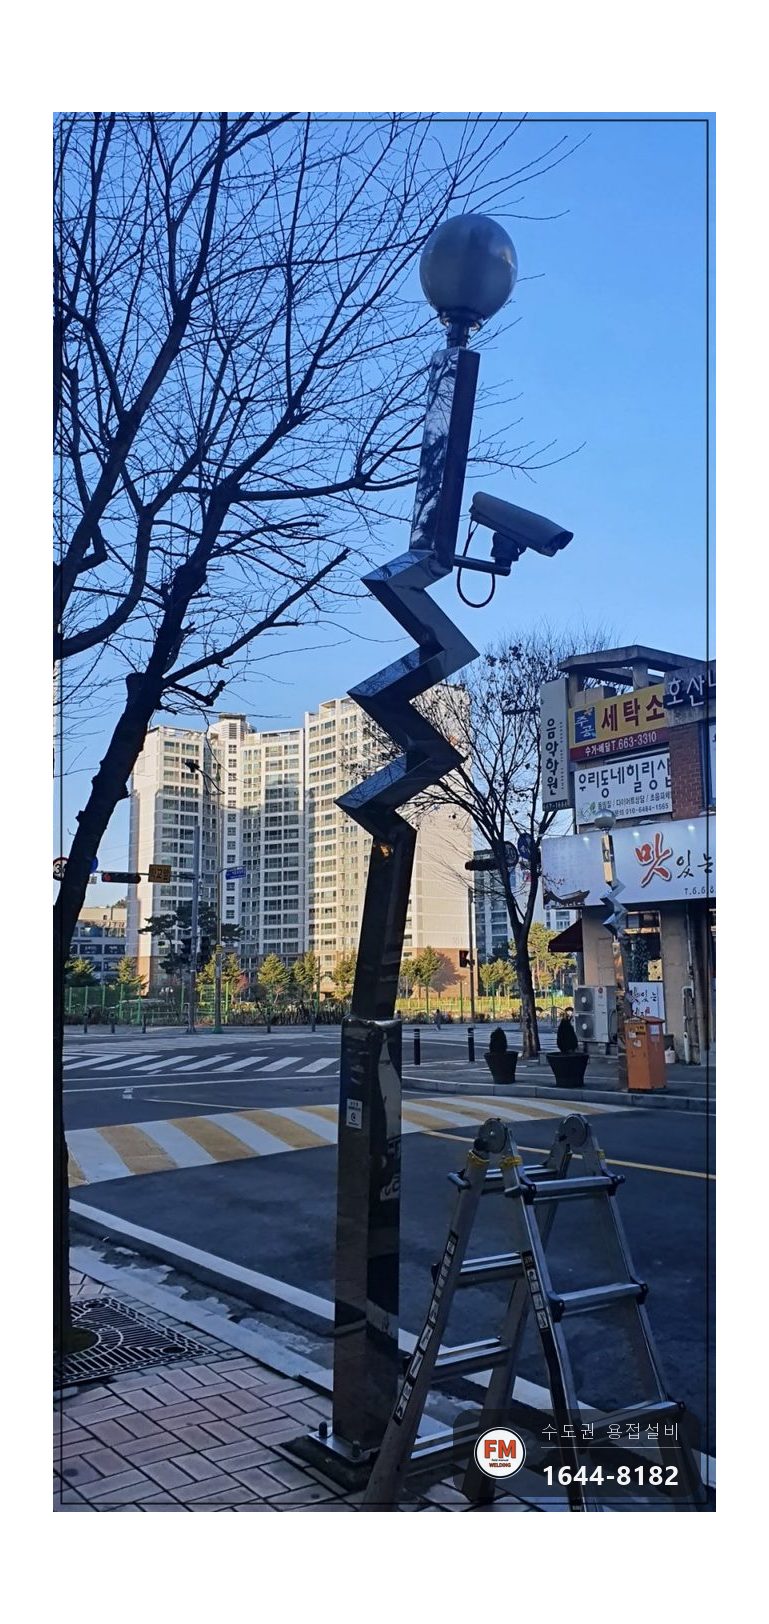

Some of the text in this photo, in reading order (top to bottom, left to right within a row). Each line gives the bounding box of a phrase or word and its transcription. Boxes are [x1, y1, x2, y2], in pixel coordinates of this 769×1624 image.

[601, 695, 665, 732] 세탁소
[545, 718, 559, 796] 음악학원
[634, 832, 714, 887] 맛있는
